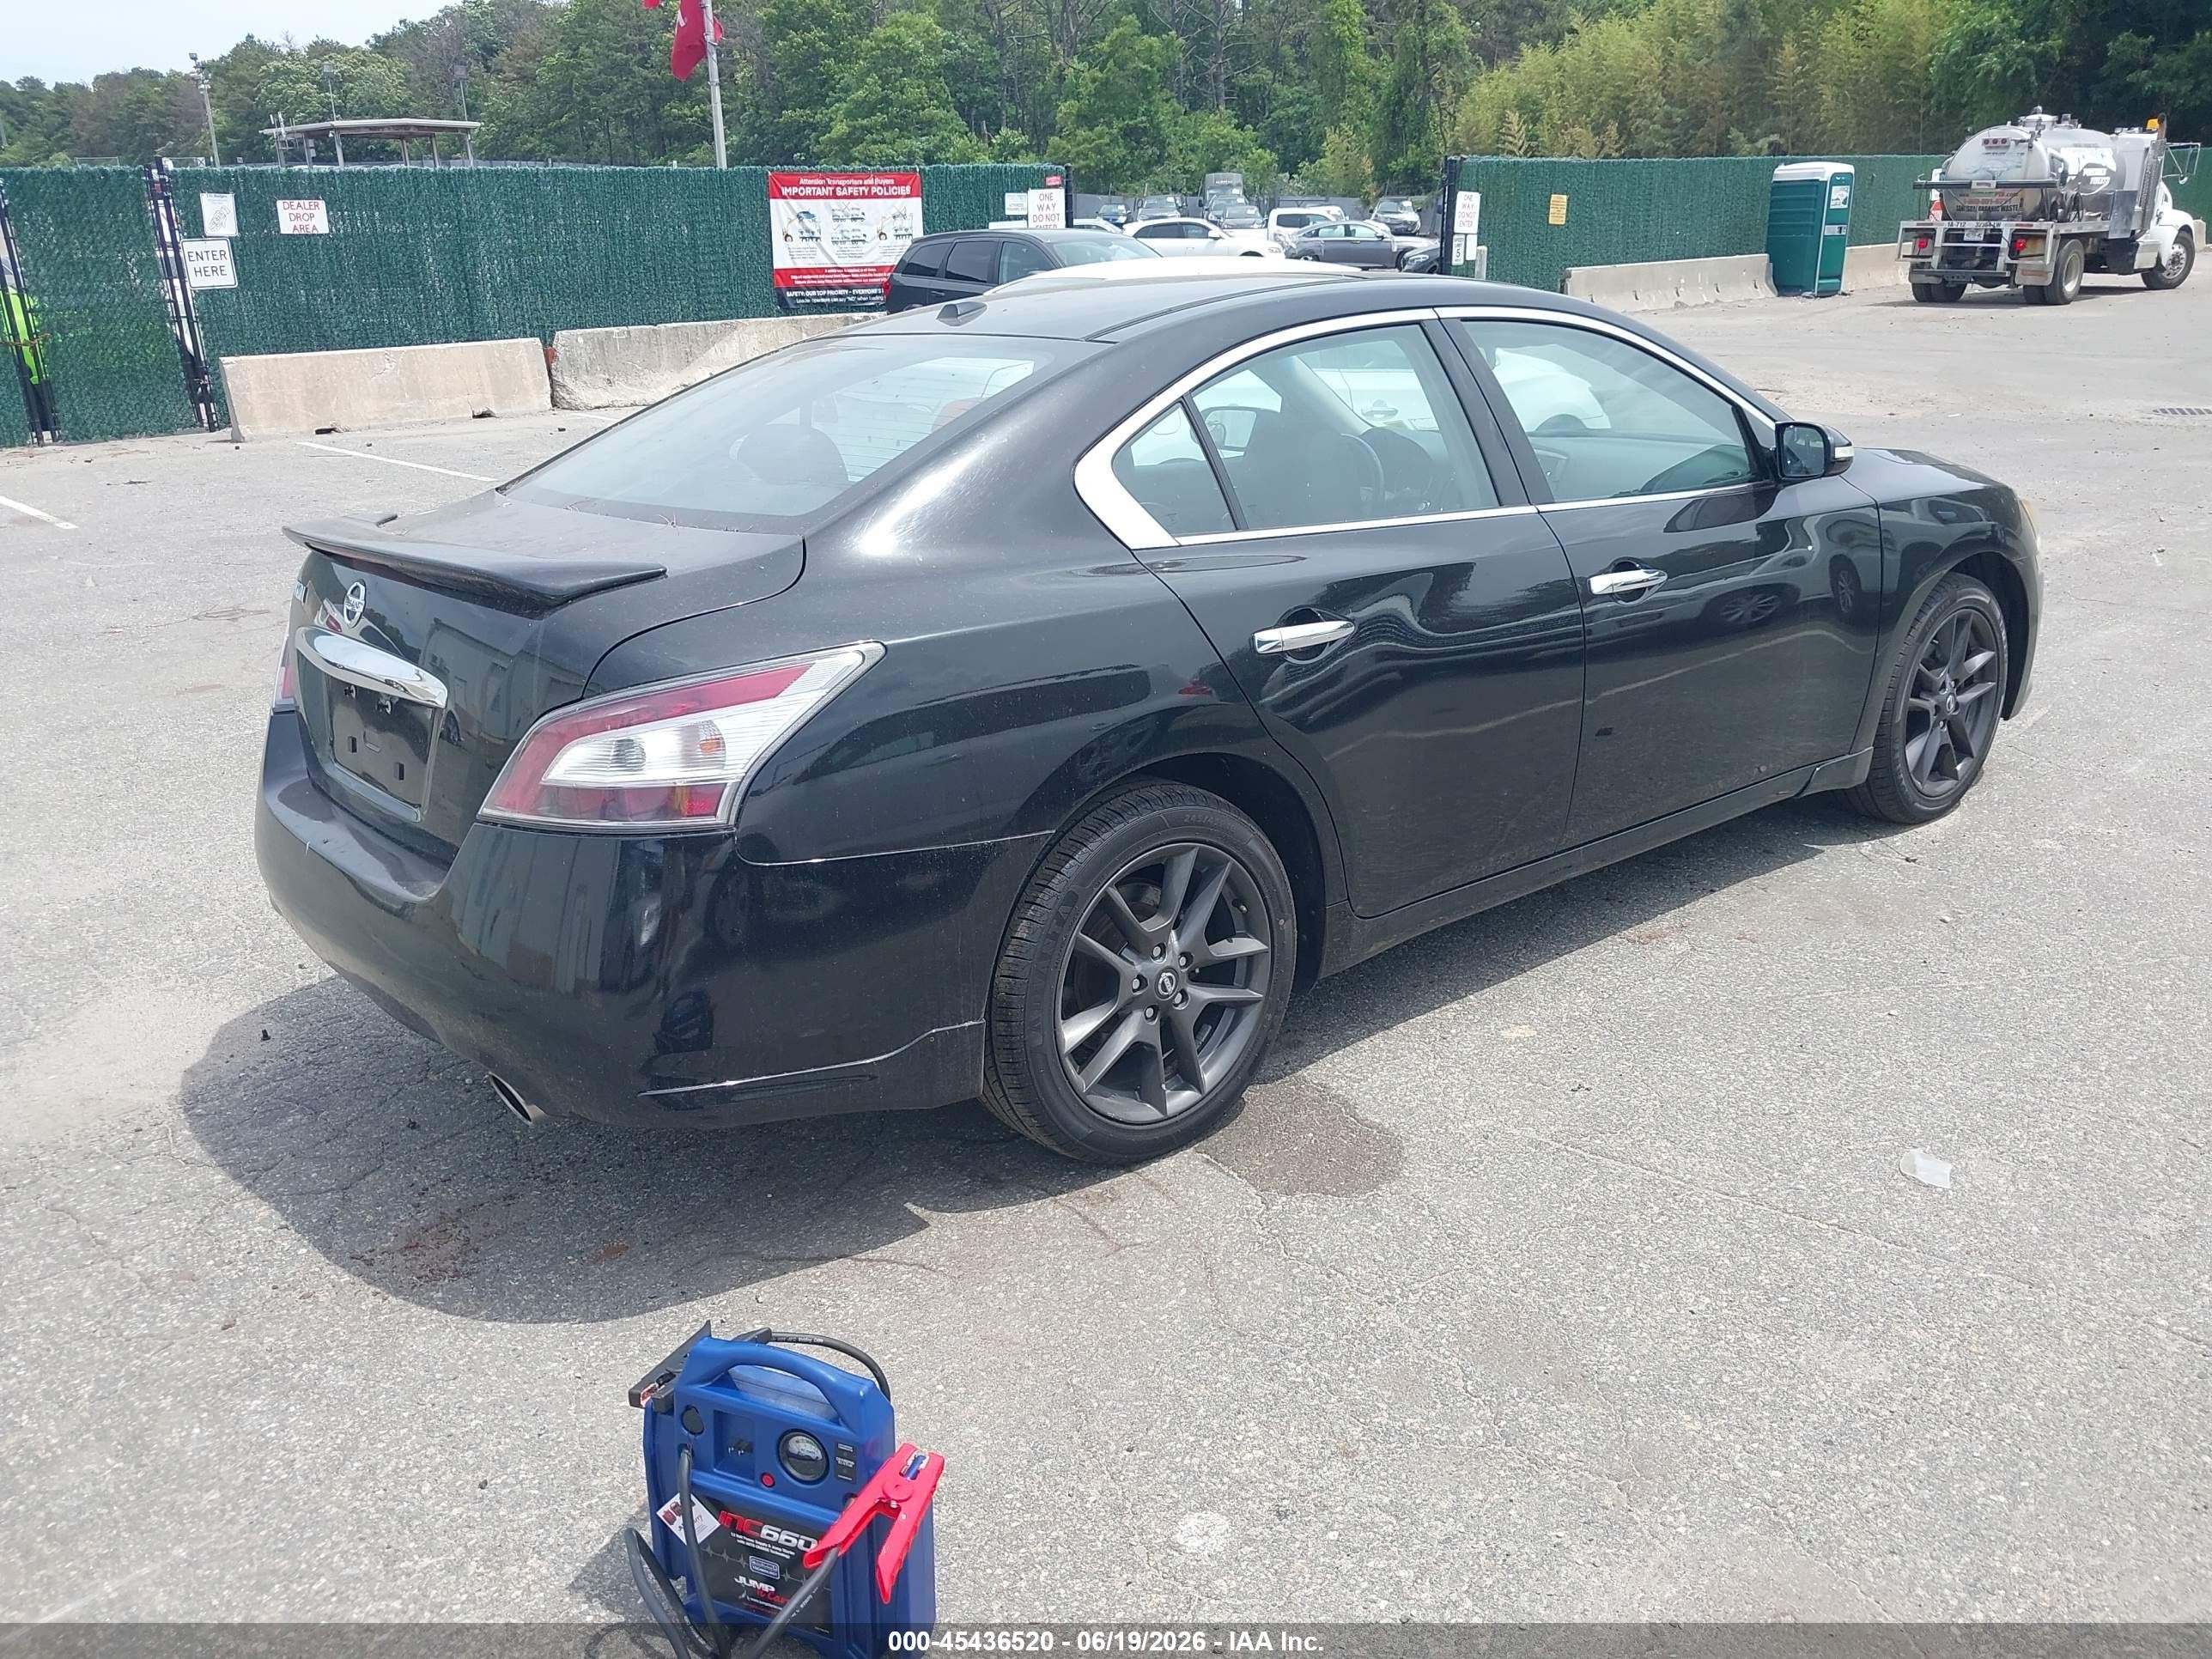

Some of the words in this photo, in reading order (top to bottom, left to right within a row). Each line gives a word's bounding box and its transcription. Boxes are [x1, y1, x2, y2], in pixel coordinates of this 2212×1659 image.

[781, 186, 835, 197] IMPORTANT
[836, 186, 870, 196] SAFETY
[872, 185, 911, 195] POLICIES
[1039, 192, 1054, 202] ONE
[283, 201, 320, 210] DEALER
[1036, 203, 1056, 212] WAY
[289, 213, 315, 222] DROP
[1032, 214, 1044, 223] DO
[1045, 213, 1060, 222] NOT
[292, 224, 319, 234] AREA
[187, 249, 228, 262] ENTER
[1456, 248, 1461, 258] 5
[193, 265, 228, 277] HERE
[734, 1575, 775, 1593] JUMP
